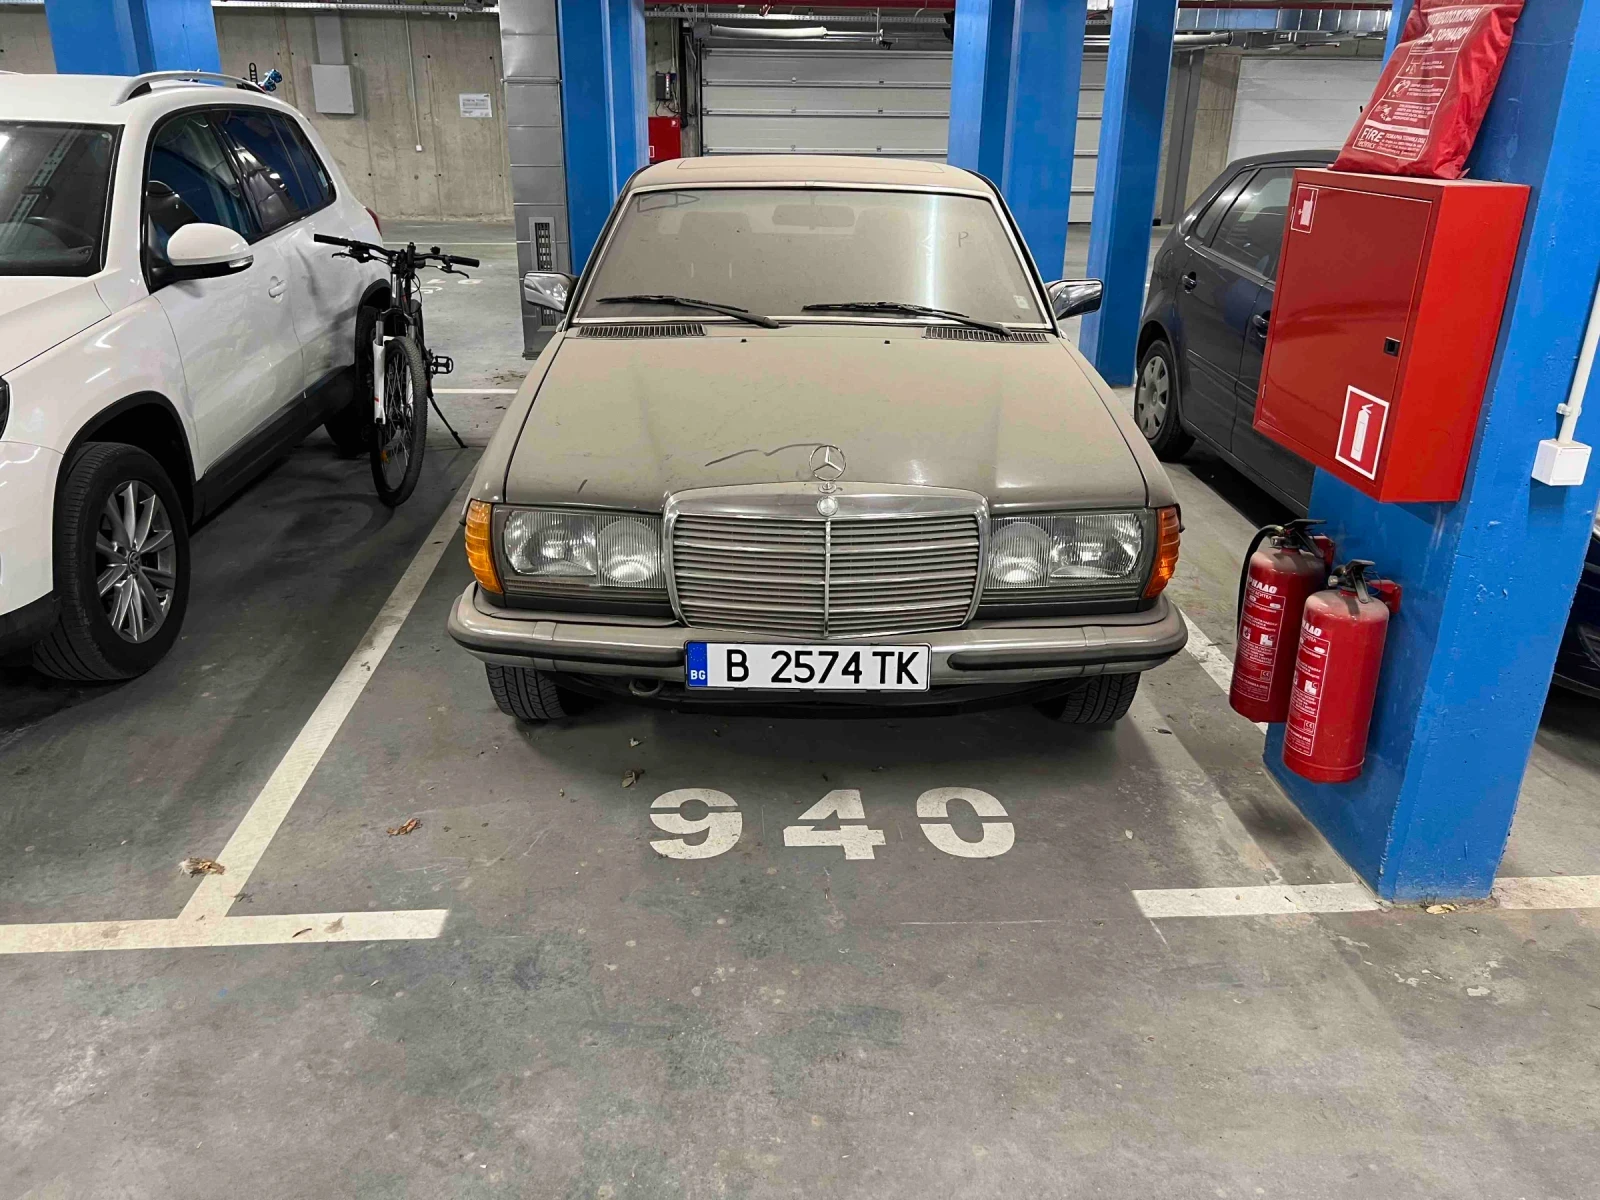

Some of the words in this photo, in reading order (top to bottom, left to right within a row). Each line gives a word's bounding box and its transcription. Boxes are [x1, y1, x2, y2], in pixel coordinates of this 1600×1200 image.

[690, 670, 706, 680] BG
[726, 649, 749, 682] B
[770, 650, 863, 684] 2574
[872, 651, 920, 685] TK
